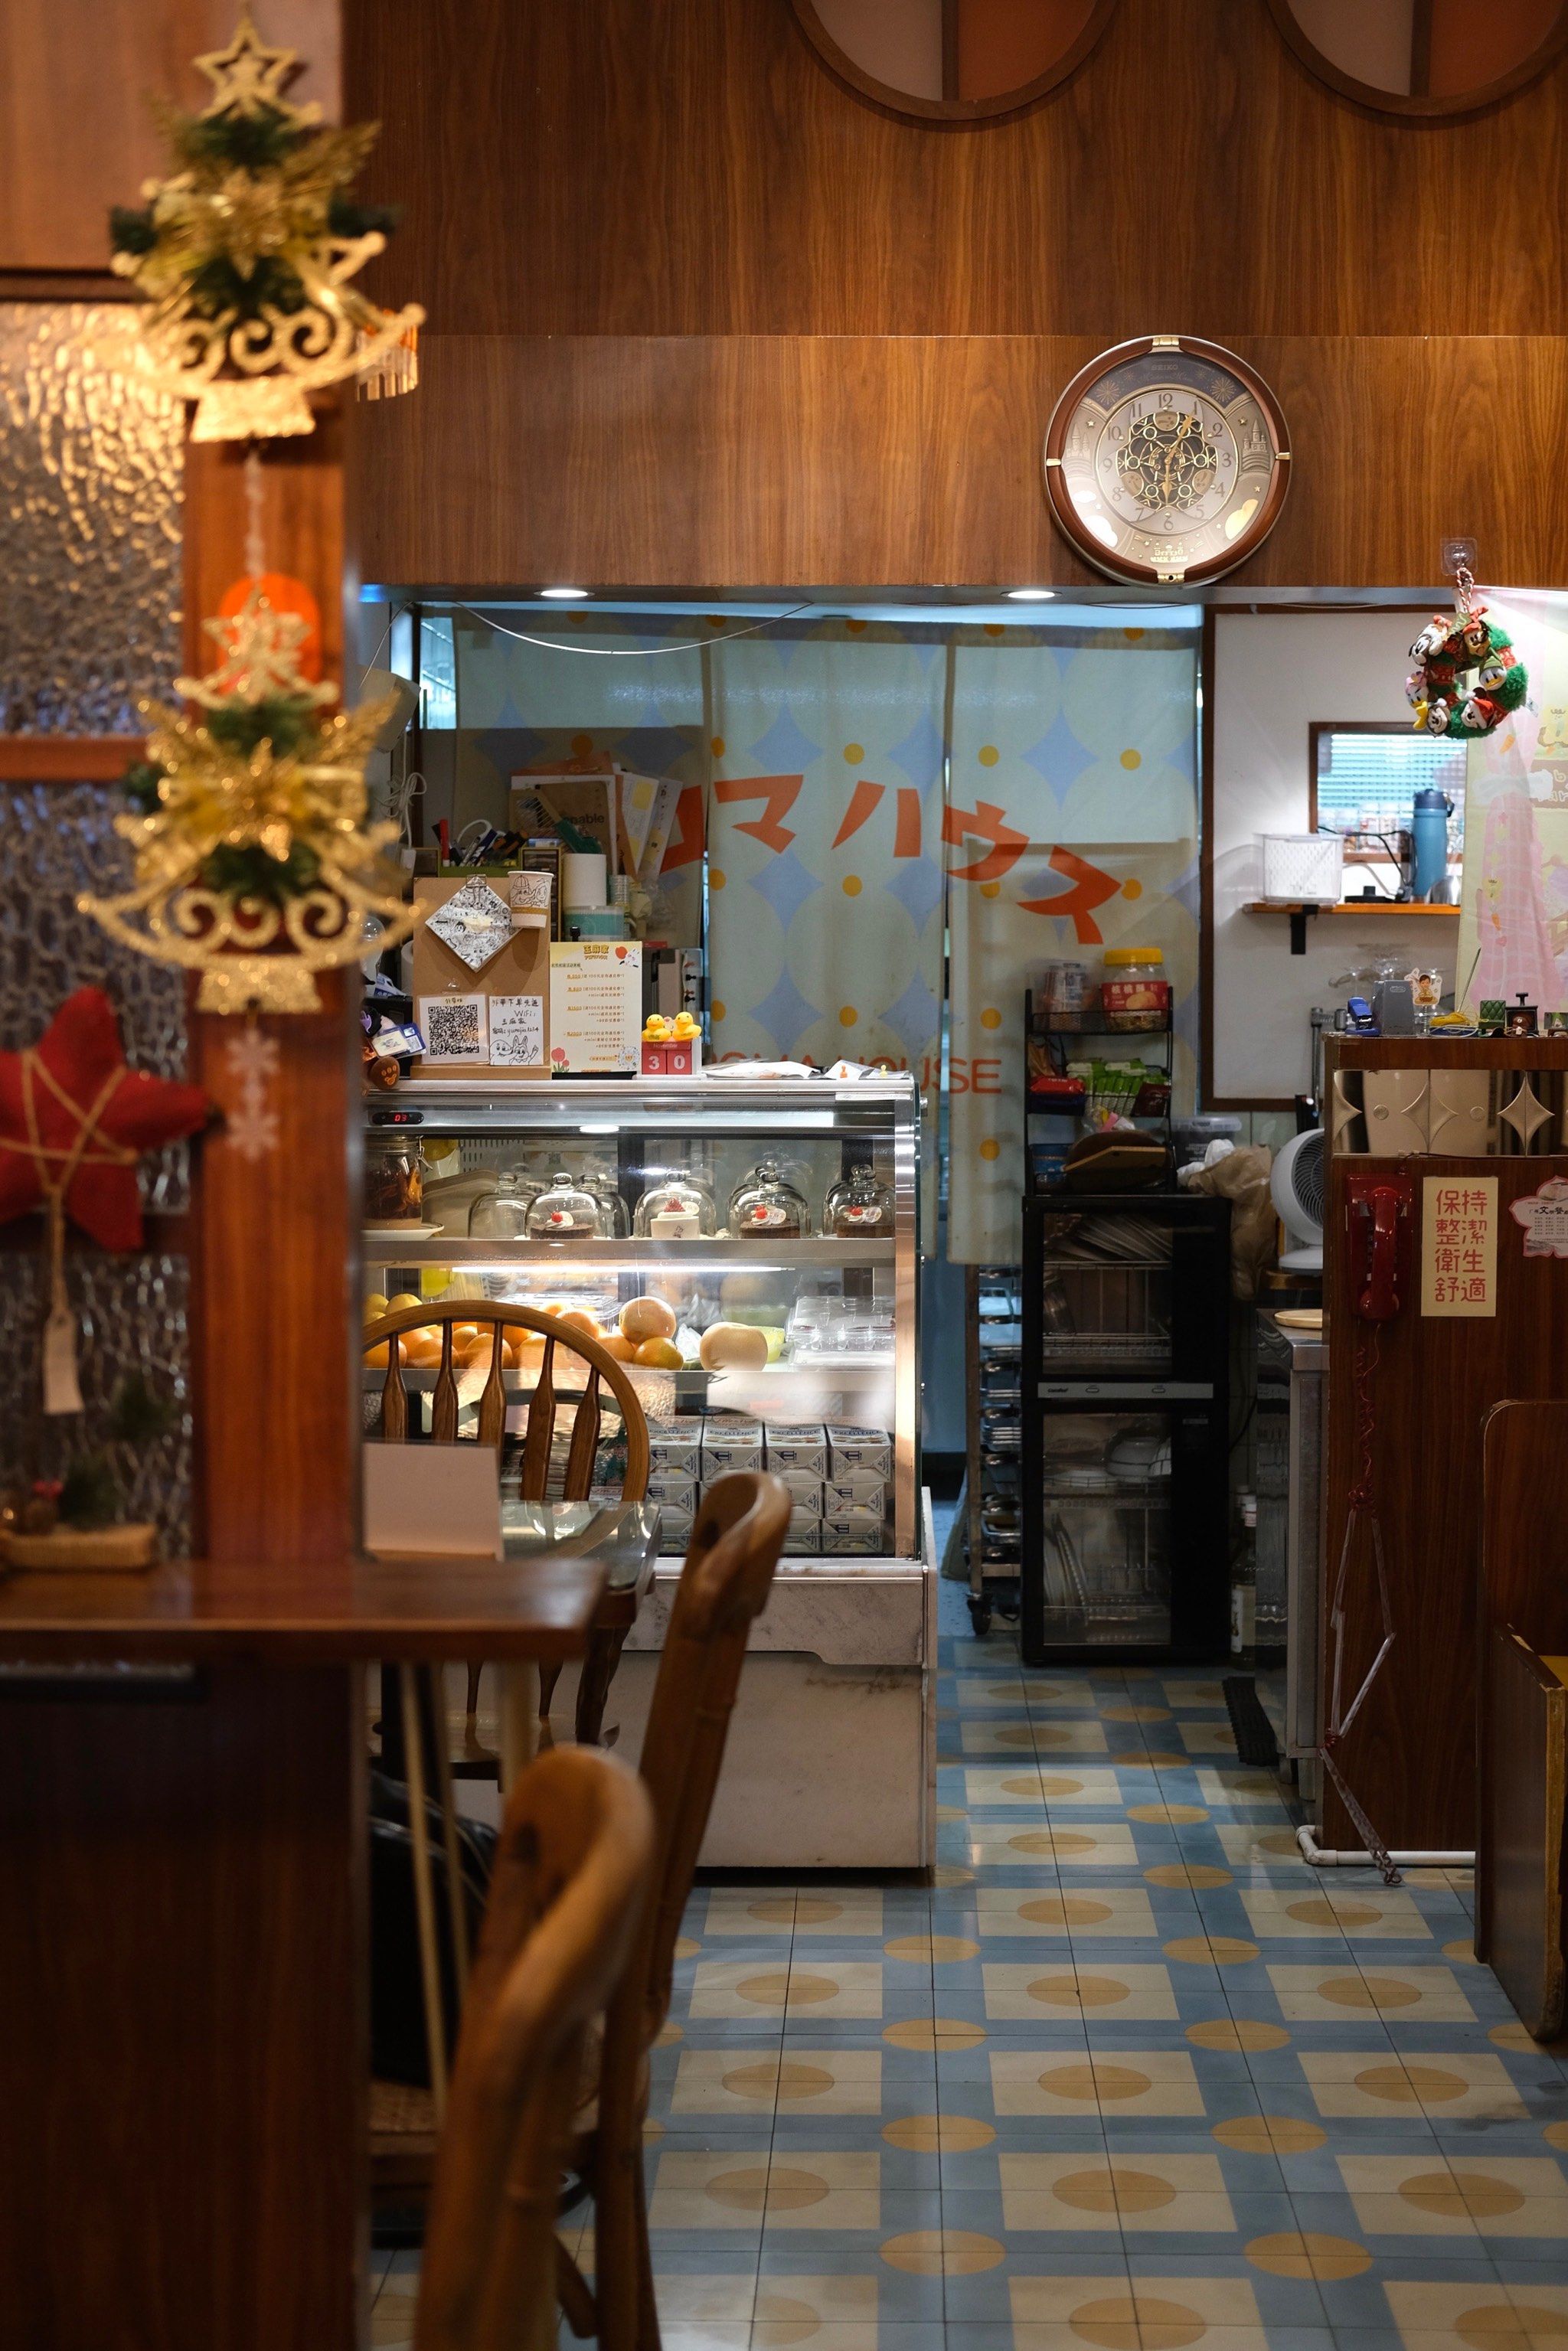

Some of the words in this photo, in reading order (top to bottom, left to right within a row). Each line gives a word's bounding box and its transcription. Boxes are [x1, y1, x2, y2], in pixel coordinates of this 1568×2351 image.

[1158, 393, 1173, 408] 12
[1193, 400, 1198, 416] 1
[1132, 403, 1143, 417] 11
[1107, 425, 1122, 441] 10
[1213, 423, 1223, 437] 2
[1102, 458, 1112, 473] 9
[1221, 452, 1232, 468] 3
[1112, 487, 1122, 501] 8
[1214, 482, 1226, 498] 4
[1135, 508, 1145, 522] 7
[1196, 504, 1204, 520] 5
[1164, 515, 1174, 531] 6
[648, 1055, 660, 1070] 3
[674, 1054, 686, 1070] 0
[1436, 1188, 1488, 1216] 保持
[1436, 1217, 1488, 1246] 整潔
[1436, 1249, 1485, 1274] 衛生
[1435, 1277, 1487, 1304] 舒適
